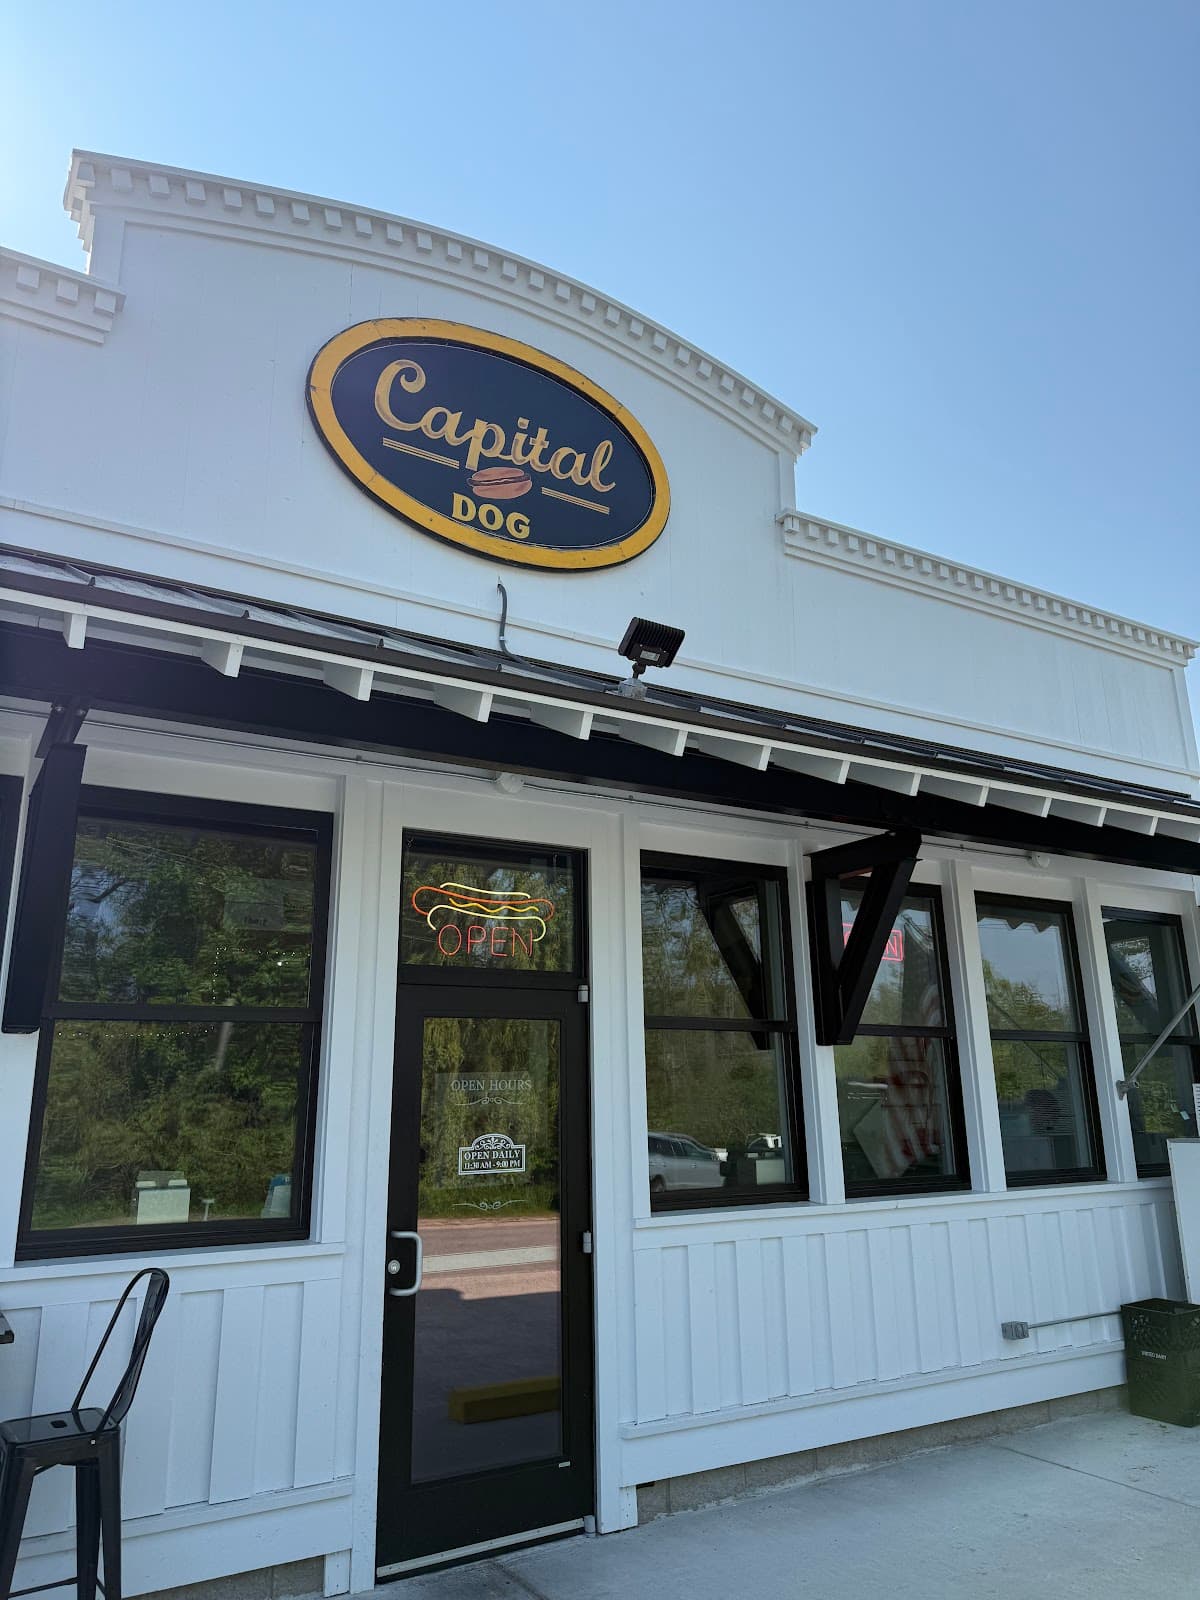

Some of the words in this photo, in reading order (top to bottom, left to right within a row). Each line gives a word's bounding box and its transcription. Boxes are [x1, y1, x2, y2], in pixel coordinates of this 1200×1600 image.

[374, 359, 616, 493] Capital
[452, 492, 531, 539] DOG
[437, 924, 533, 957] OPEN
[451, 1079, 485, 1092] OPEN
[489, 1079, 532, 1091] HOURS
[464, 1151, 490, 1160] OPEN
[492, 1150, 520, 1159] DAILY
[480, 1160, 491, 1169] AM
[509, 1159, 520, 1168] PM
